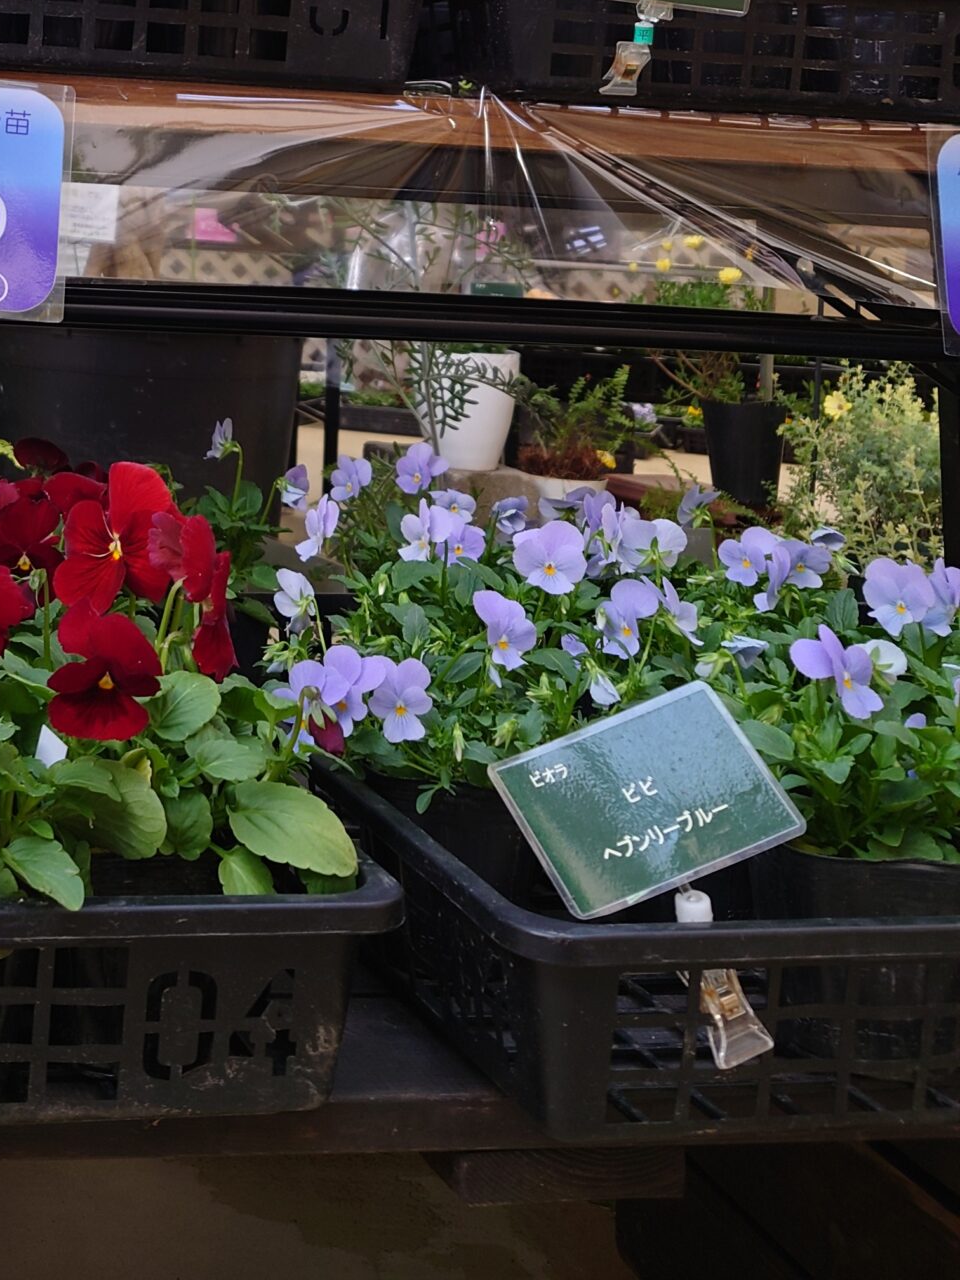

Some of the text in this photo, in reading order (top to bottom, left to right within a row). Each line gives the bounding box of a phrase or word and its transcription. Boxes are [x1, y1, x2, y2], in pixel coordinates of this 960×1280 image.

[529, 763, 568, 788] ビオラ
[603, 803, 729, 860] ヘブンリーブルー
[142, 968, 297, 1081] 04
